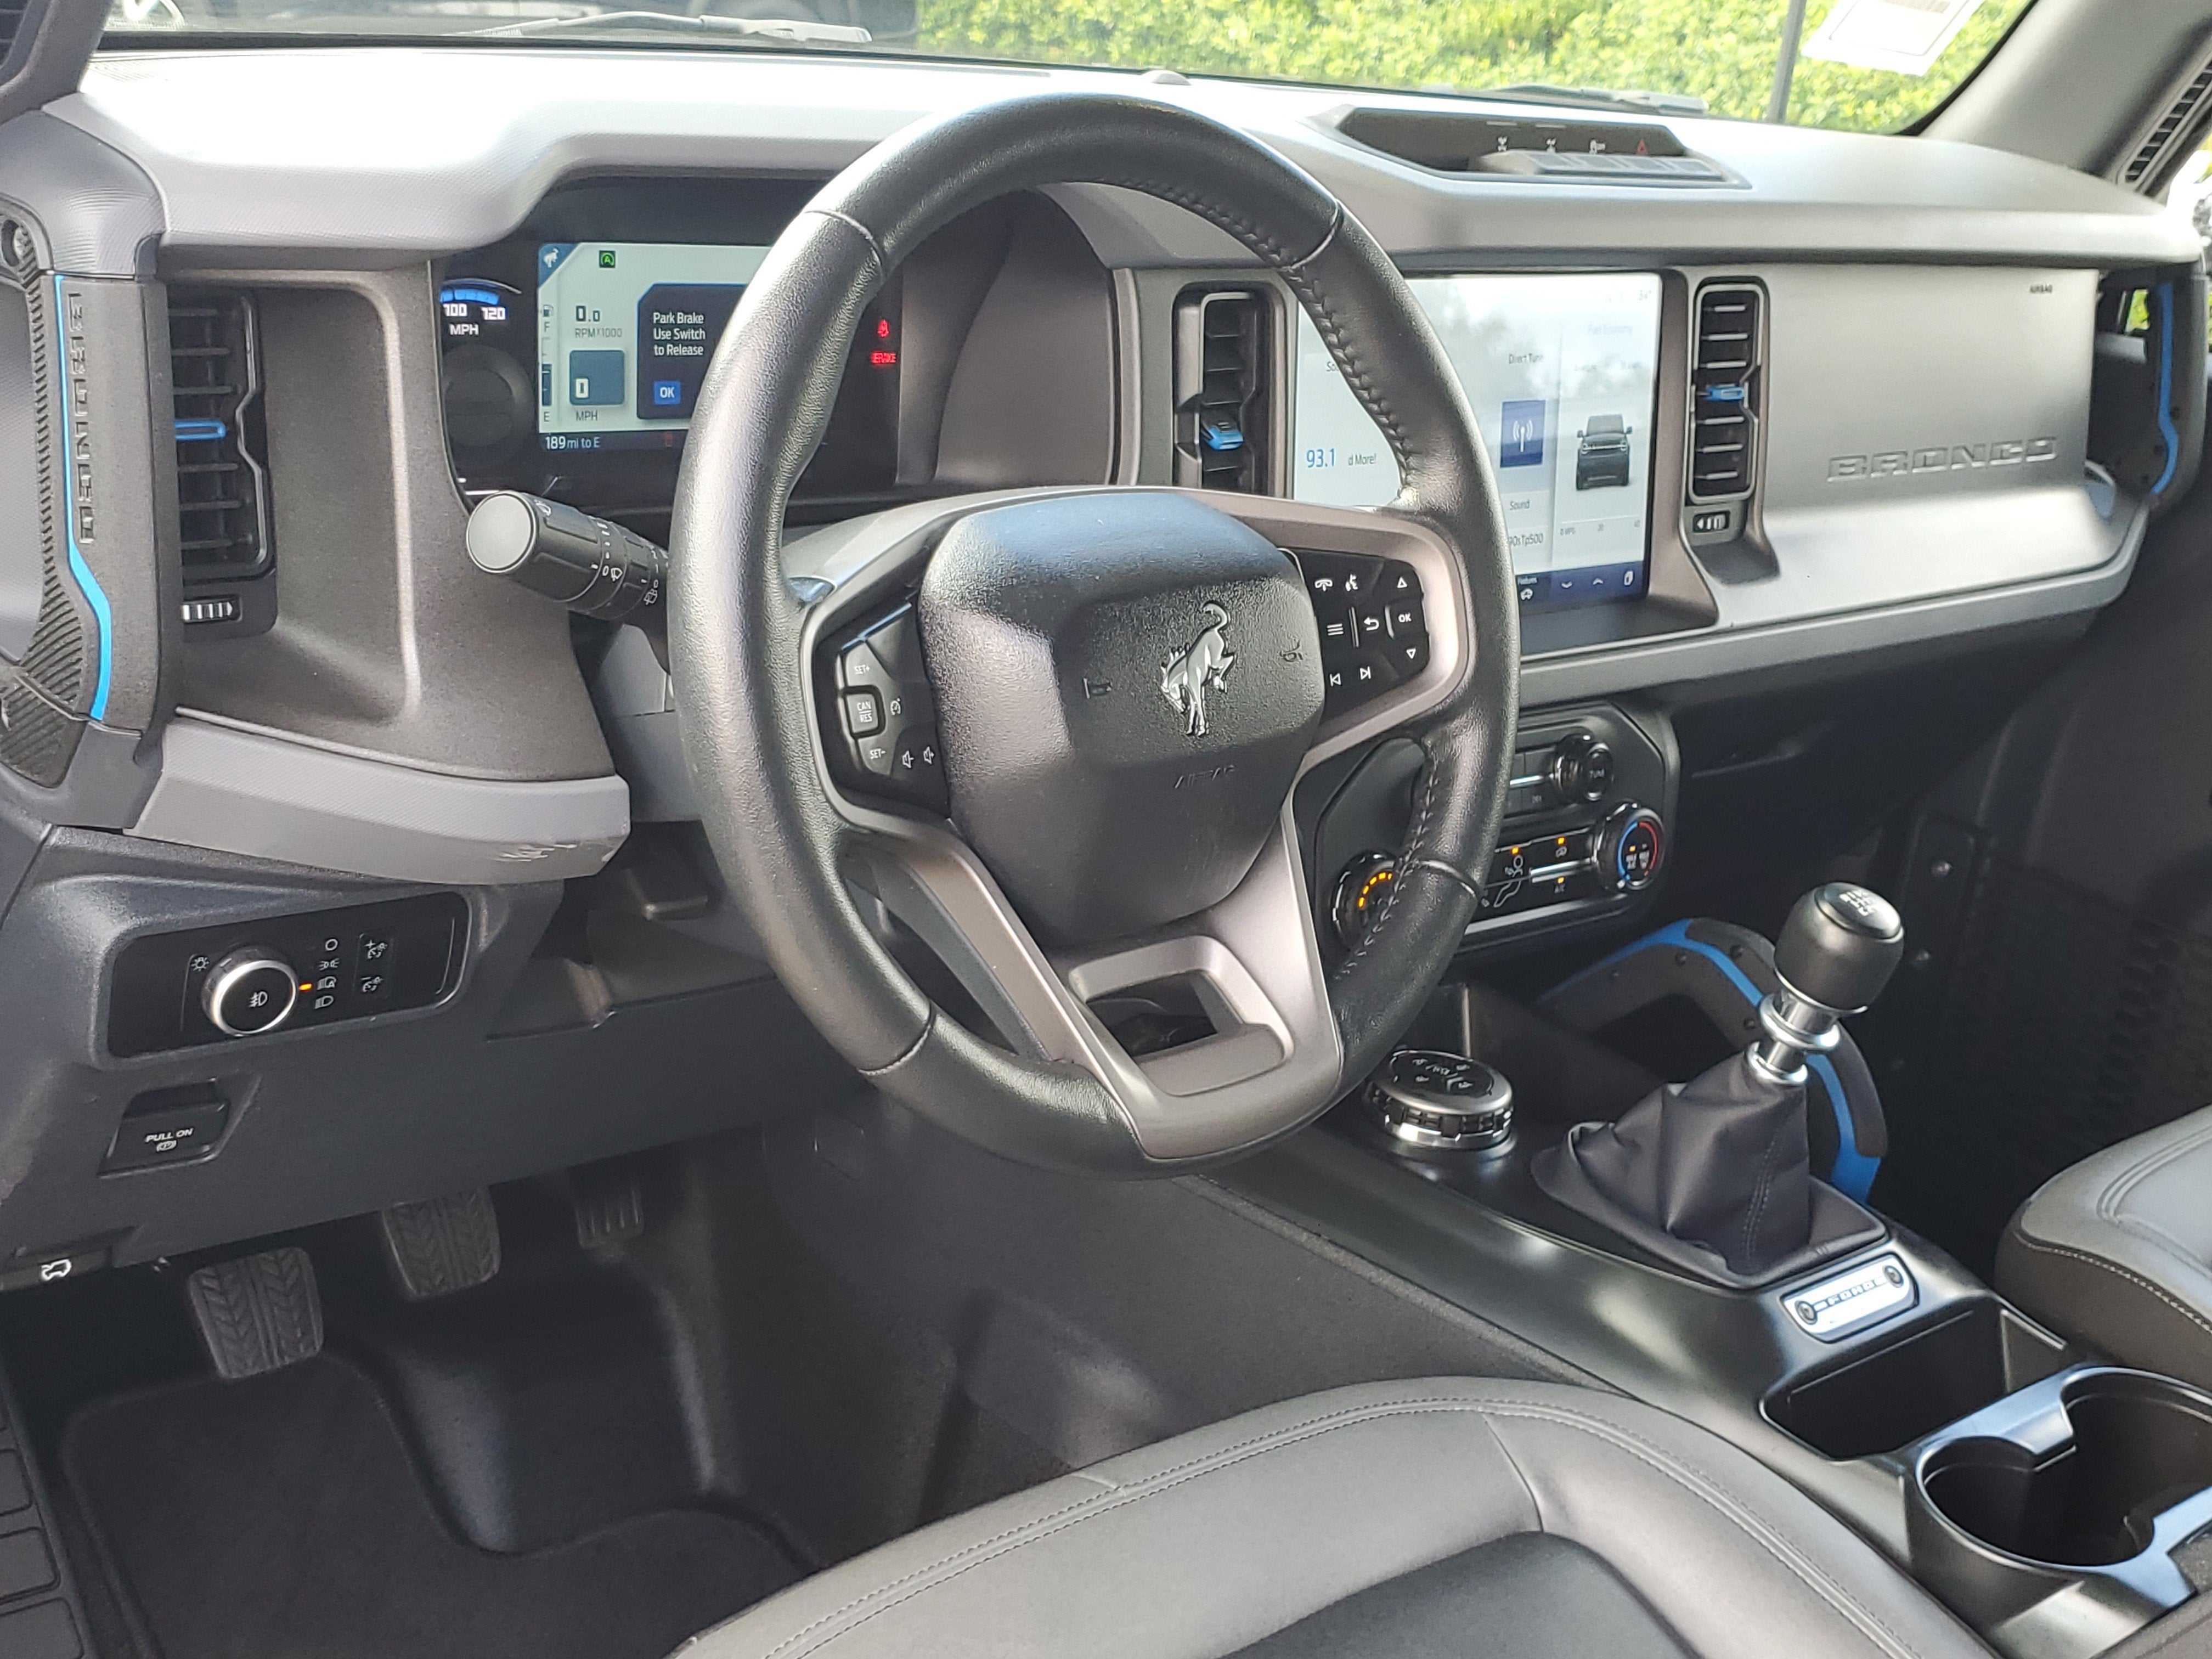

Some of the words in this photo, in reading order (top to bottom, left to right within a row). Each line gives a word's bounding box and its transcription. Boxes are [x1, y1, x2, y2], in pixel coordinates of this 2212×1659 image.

[443, 303, 467, 317] 100
[481, 307, 506, 320] 120
[575, 306, 600, 322] 0.0
[653, 312, 675, 324] Park
[677, 312, 704, 324] Brake
[450, 323, 479, 335] MPH
[653, 328, 672, 340] Use
[673, 328, 706, 340] Switch
[654, 344, 664, 356] to
[667, 343, 703, 356] Release
[575, 377, 589, 399] 0
[660, 387, 675, 398] OK
[69, 292, 94, 544] BRONCO
[576, 411, 598, 421] MPH
[545, 436, 566, 449] 189
[567, 438, 578, 449] mi
[582, 438, 591, 448] to
[594, 437, 600, 448] E
[1306, 448, 1334, 467] 93.1
[1356, 453, 1376, 465] More!
[1827, 437, 2056, 481] BRONCO
[1509, 499, 1531, 510] Sound
[1398, 612, 1412, 623] OK
[854, 664, 870, 675] SET+
[857, 701, 871, 711] CAN
[860, 713, 872, 723] RES
[870, 748, 885, 759] SET-
[145, 1132, 174, 1143] PULL
[176, 1127, 194, 1138] ON
